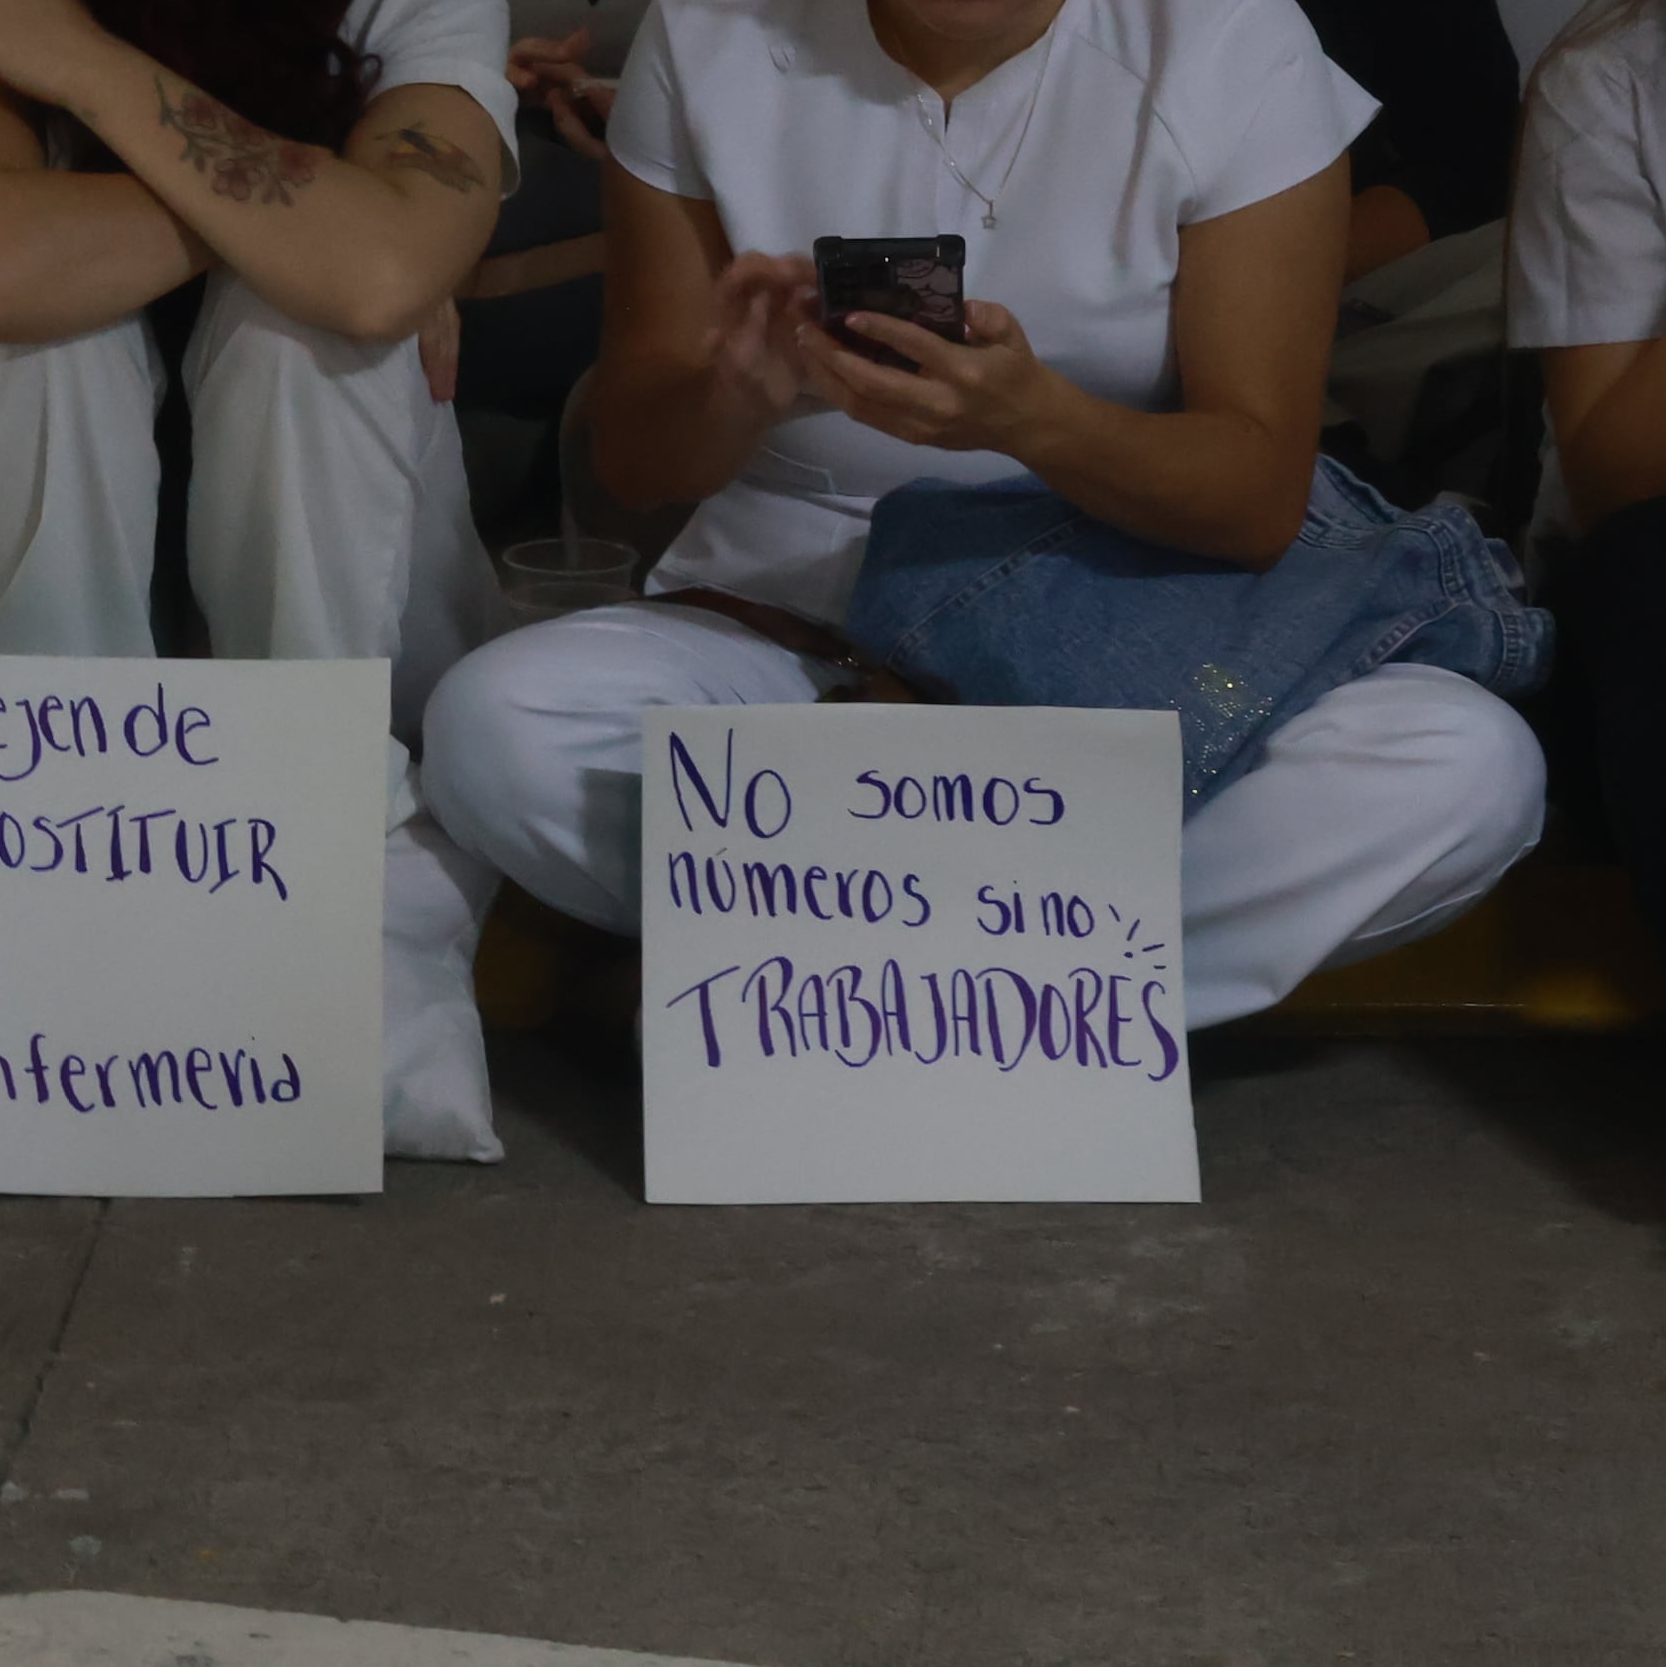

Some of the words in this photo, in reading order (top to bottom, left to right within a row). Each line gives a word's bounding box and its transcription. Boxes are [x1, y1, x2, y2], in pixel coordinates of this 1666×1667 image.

[123, 682, 219, 766] de
[847, 769, 1065, 826] somos
[667, 846, 931, 927] números
[665, 955, 1180, 1082] TRABAJADORES
